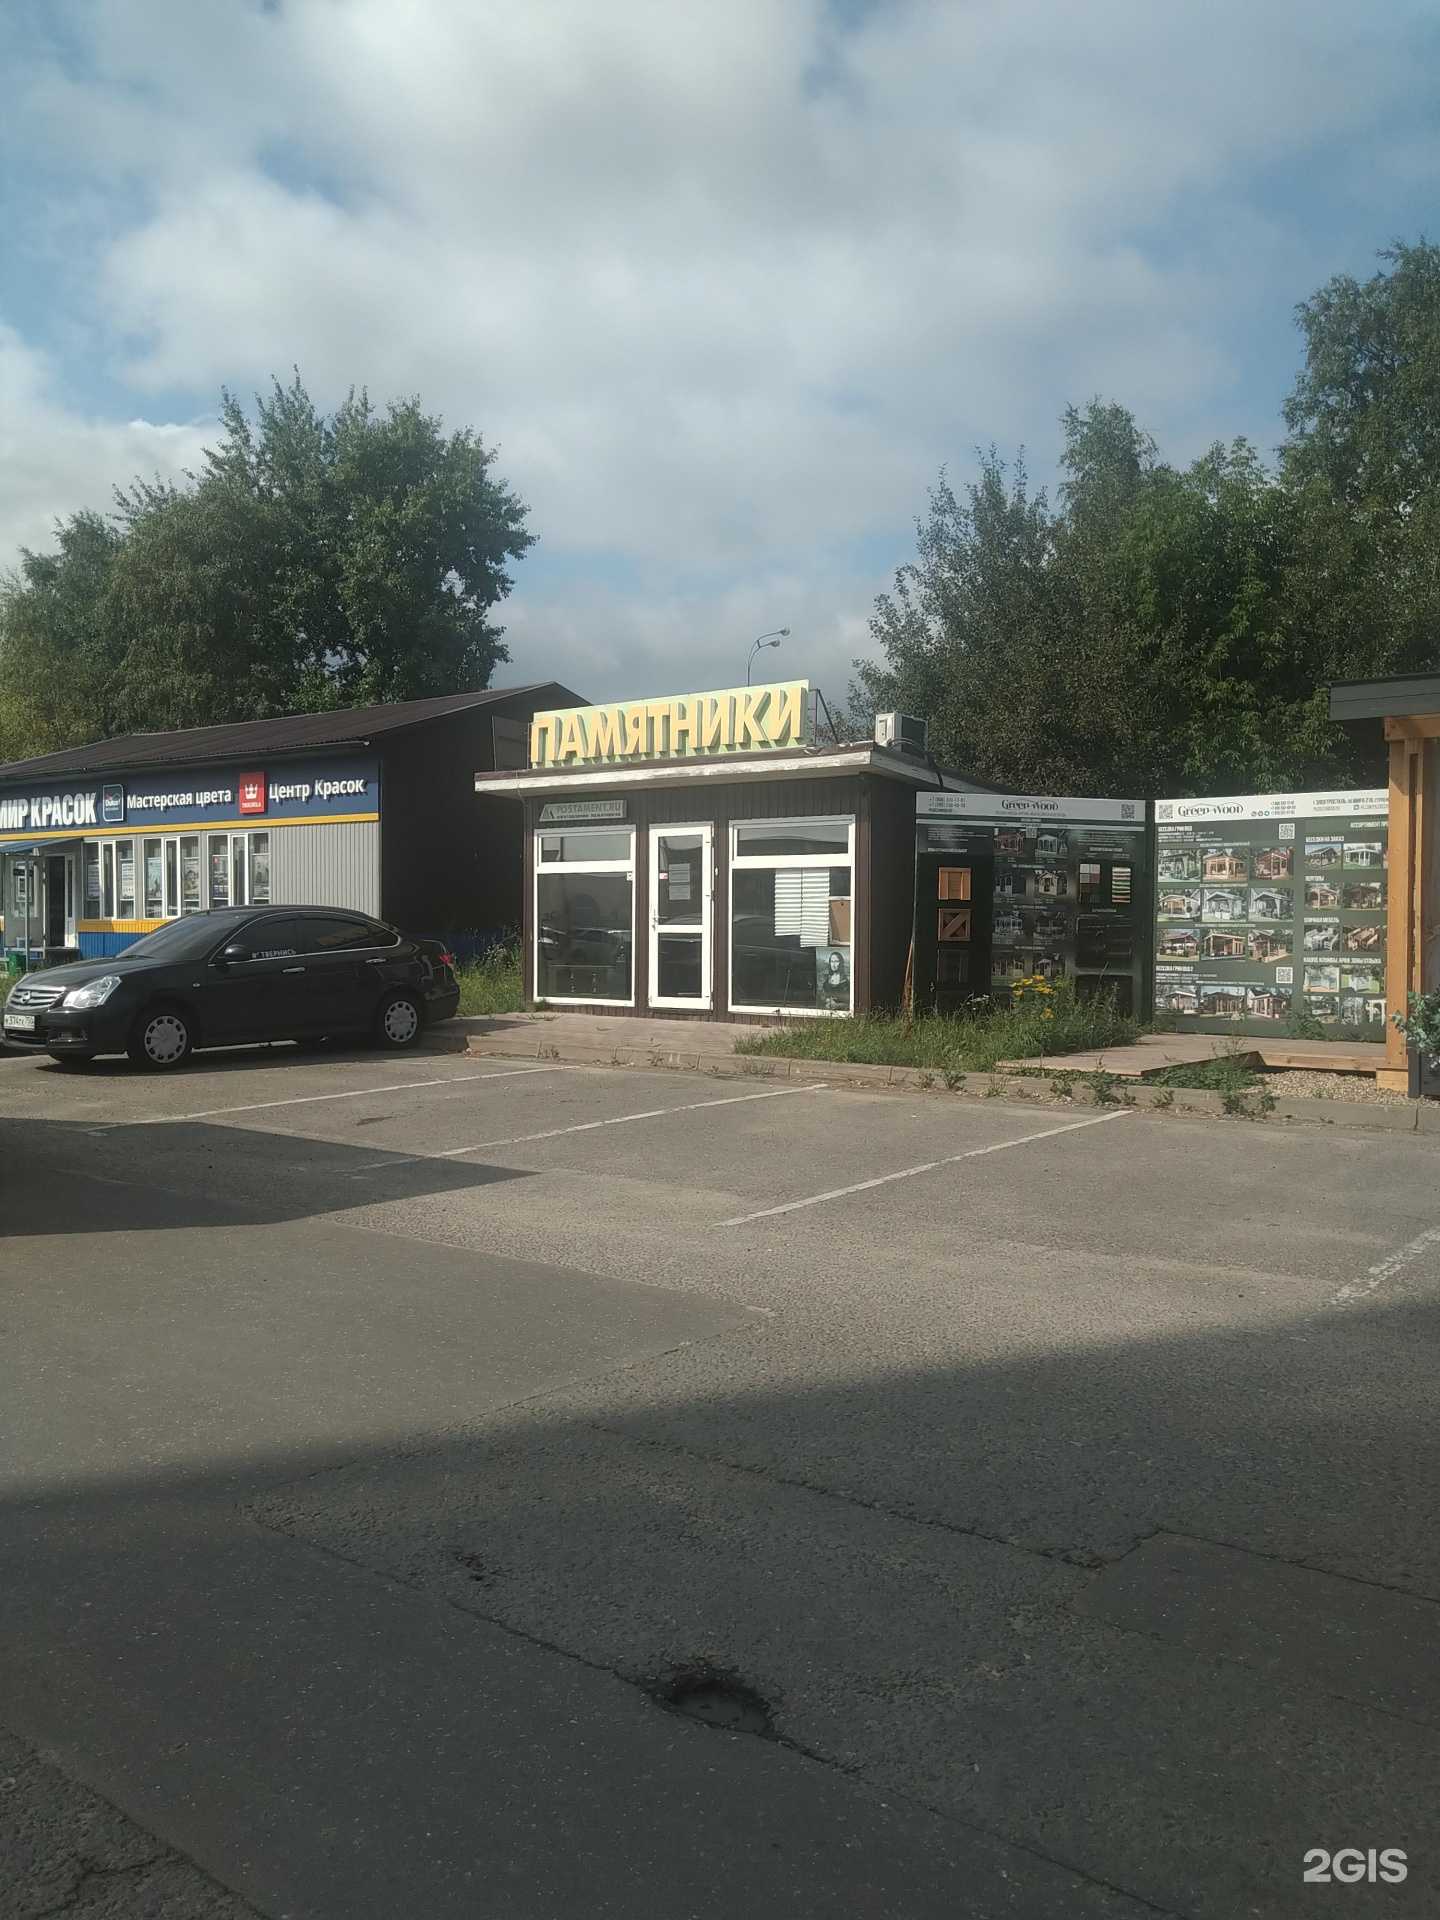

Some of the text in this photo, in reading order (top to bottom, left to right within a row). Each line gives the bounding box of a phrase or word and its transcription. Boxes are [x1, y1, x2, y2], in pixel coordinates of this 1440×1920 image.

[531, 686, 802, 763] ПАМЯТНИКИ
[126, 789, 232, 811] Мастерская цвета
[268, 778, 365, 803] Центр Красок
[31, 792, 97, 827] КРАСОК
